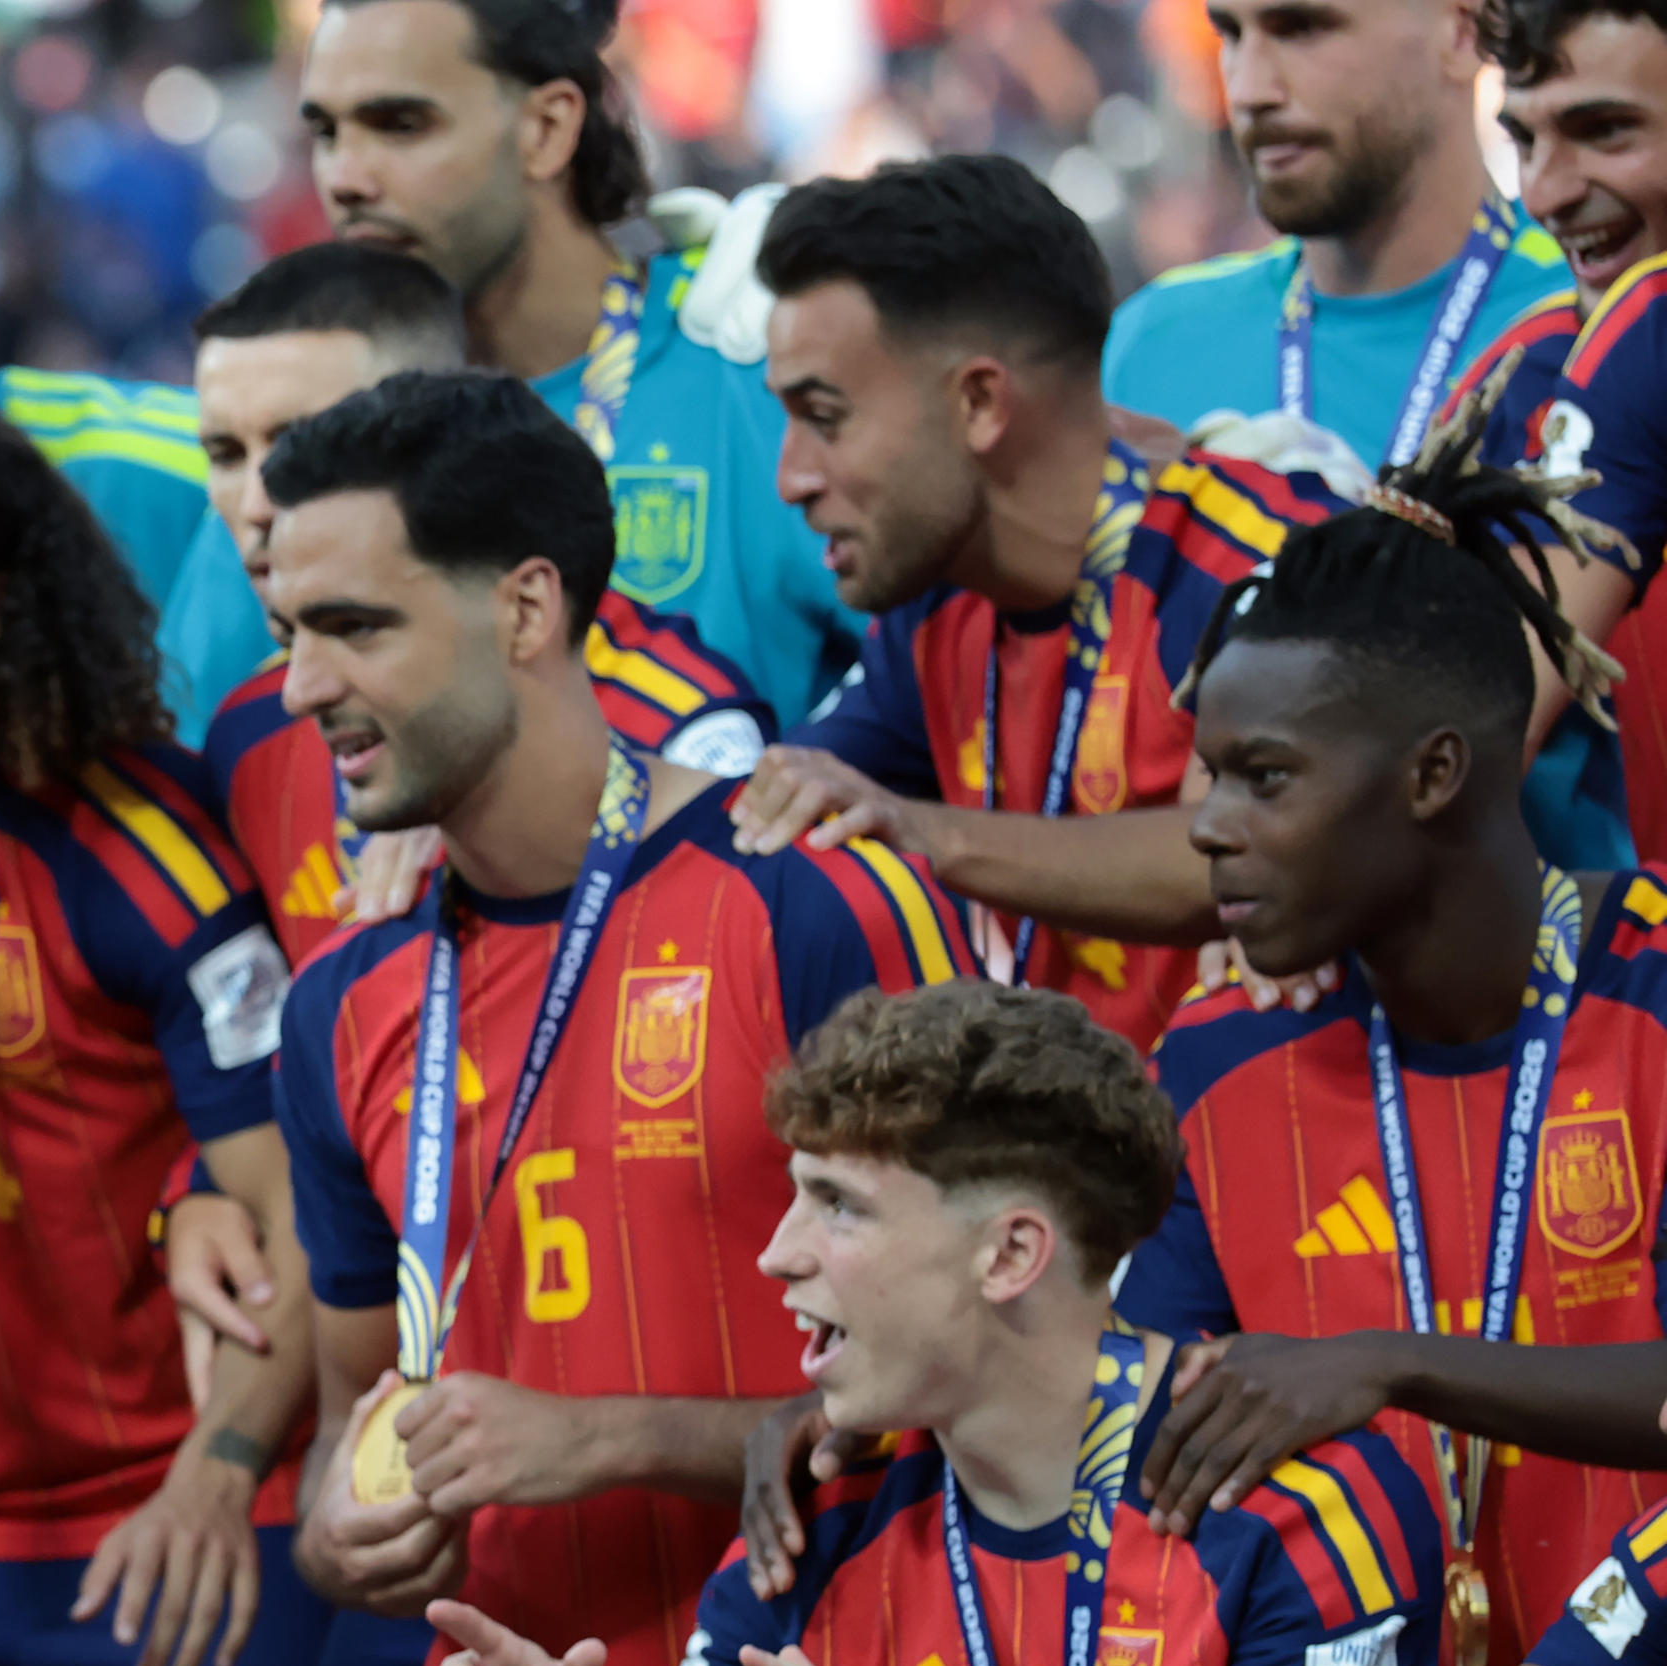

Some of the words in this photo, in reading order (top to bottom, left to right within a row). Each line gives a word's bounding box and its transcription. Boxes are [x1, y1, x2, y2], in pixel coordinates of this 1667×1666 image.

[576, 870, 612, 926] FIFA
[431, 937, 452, 990] FIFA
[546, 928, 592, 1020] WORLD
[424, 992, 449, 1083] WORLD
[530, 1019, 558, 1072] CUP
[1376, 1044, 1396, 1103] FIFA
[1511, 1039, 1547, 1135] 2026
[420, 1083, 444, 1136] CUP
[1381, 1099, 1410, 1198] WORLD
[1504, 1133, 1528, 1191] CUP
[413, 1134, 441, 1224] 2026
[514, 1147, 592, 1323] 6
[1395, 1198, 1418, 1253] CUP
[1492, 1190, 1521, 1289] WORLD
[947, 1526, 969, 1581] CUP
